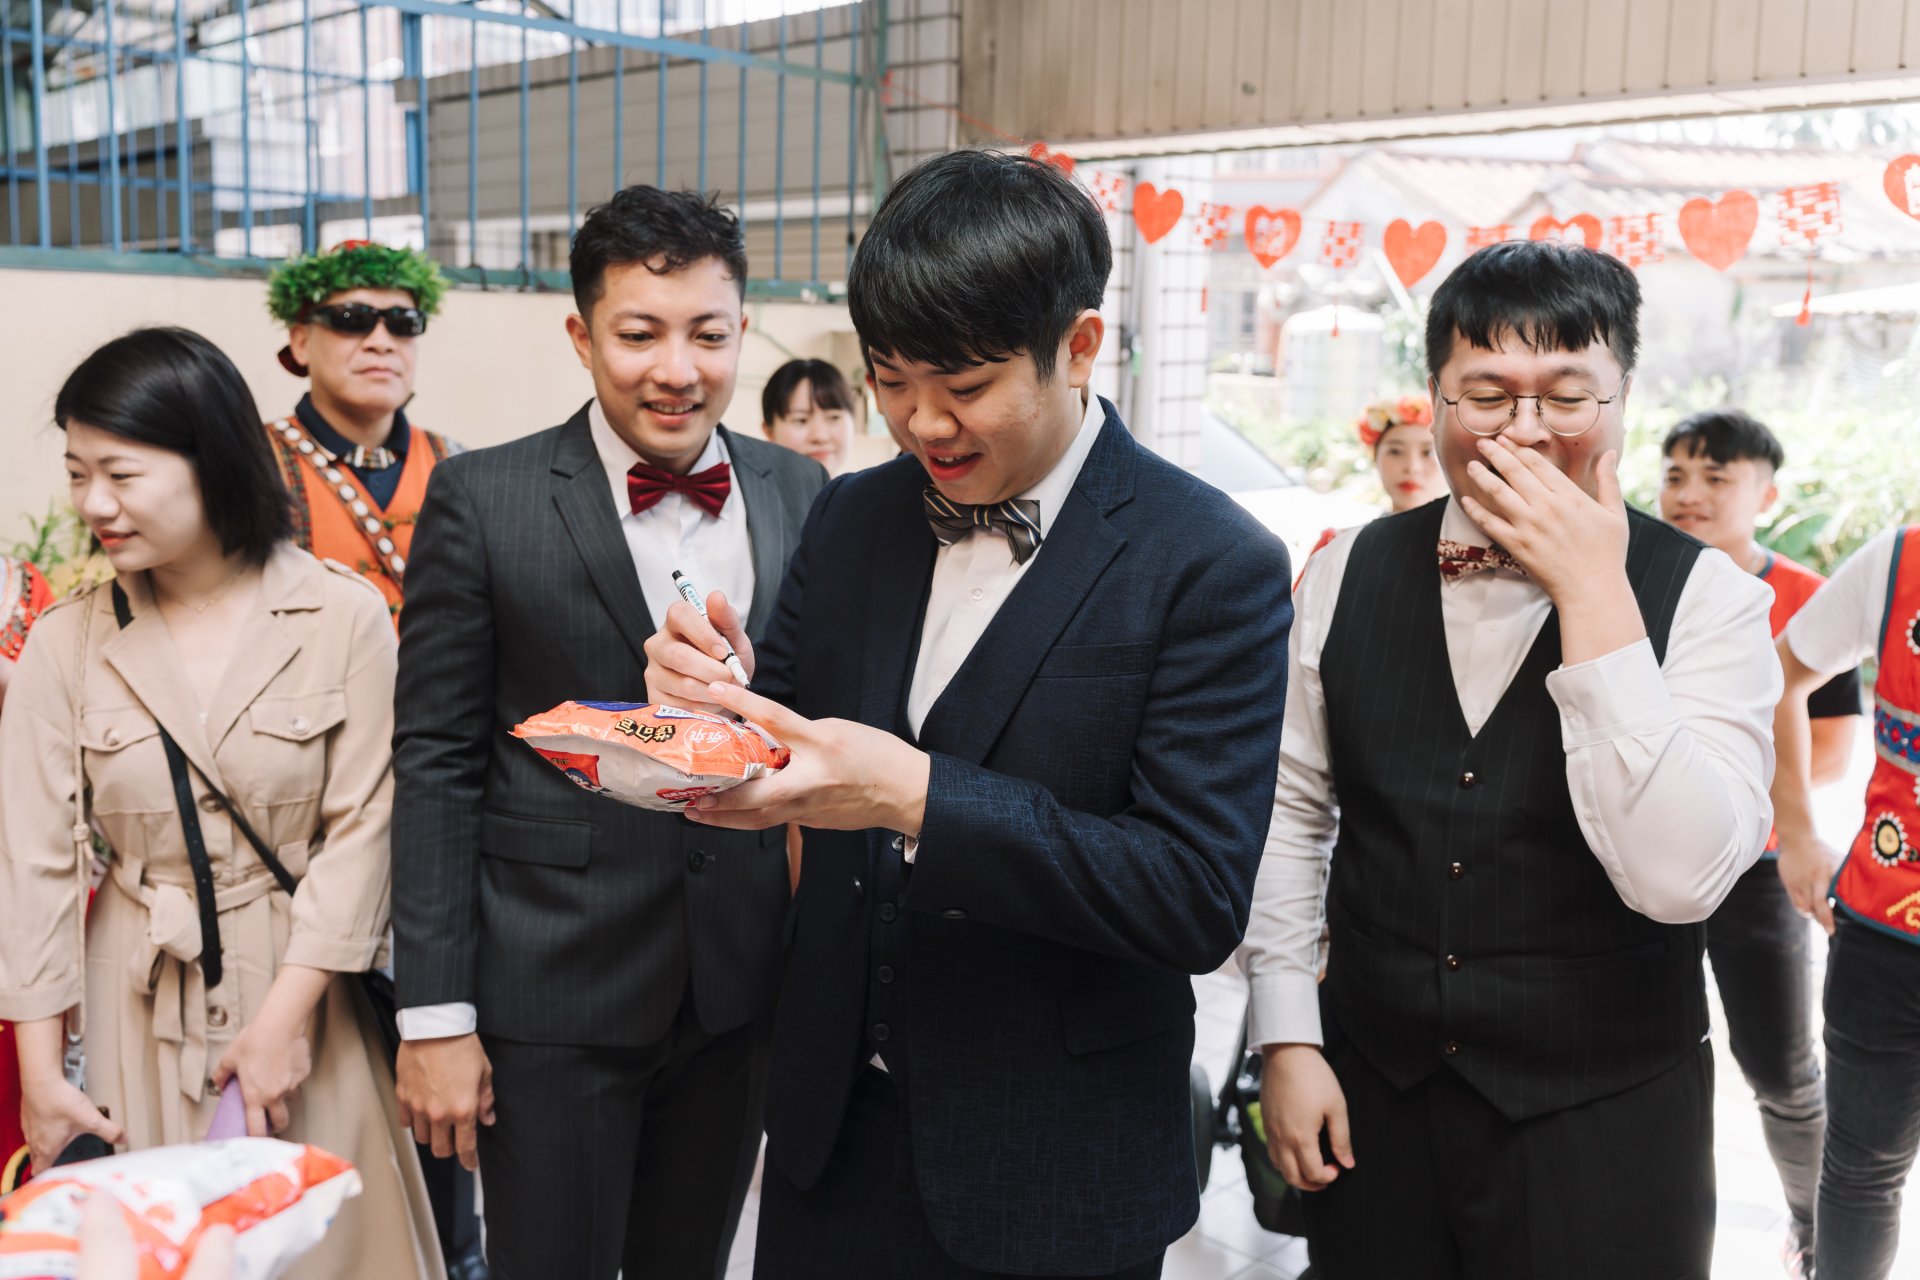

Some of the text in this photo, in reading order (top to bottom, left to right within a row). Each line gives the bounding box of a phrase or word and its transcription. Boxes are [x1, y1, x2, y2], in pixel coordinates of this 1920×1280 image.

[614, 717, 676, 744] 造句包
[688, 727, 725, 745] 乖乖
